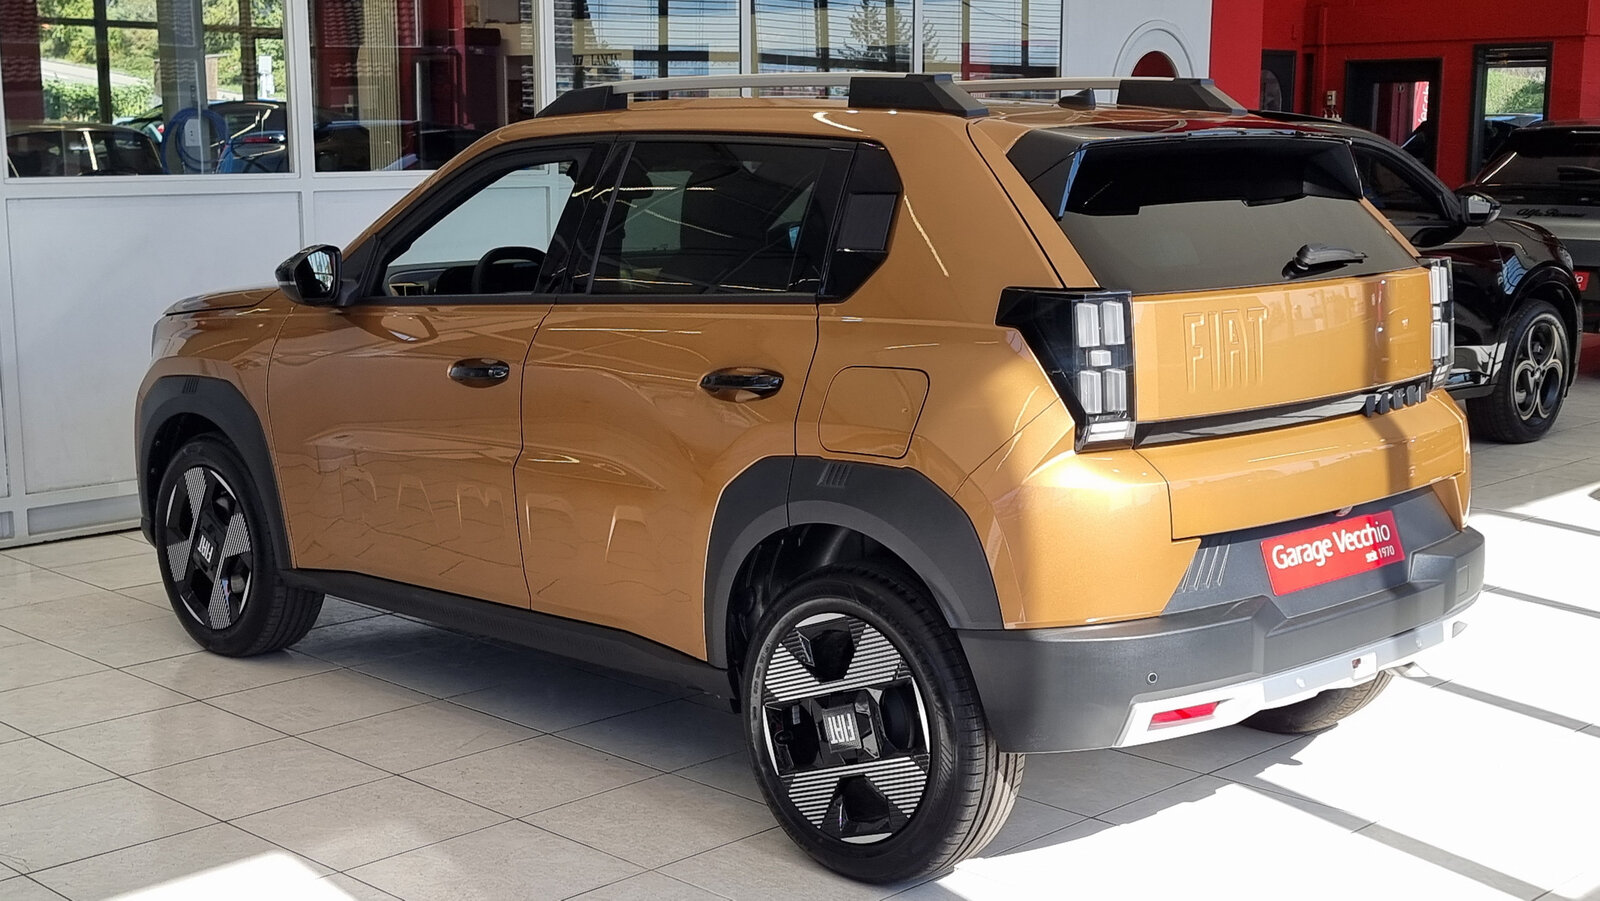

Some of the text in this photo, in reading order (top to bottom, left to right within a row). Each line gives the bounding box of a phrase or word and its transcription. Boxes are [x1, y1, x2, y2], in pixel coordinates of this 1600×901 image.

[1516, 208, 1543, 219] Alfa
[1183, 306, 1267, 391] FIAT
[197, 534, 214, 563] FIAT
[1271, 521, 1391, 570] Garage Vecchio
[1365, 545, 1395, 563] seit 1970
[828, 713, 856, 744] FIAT
